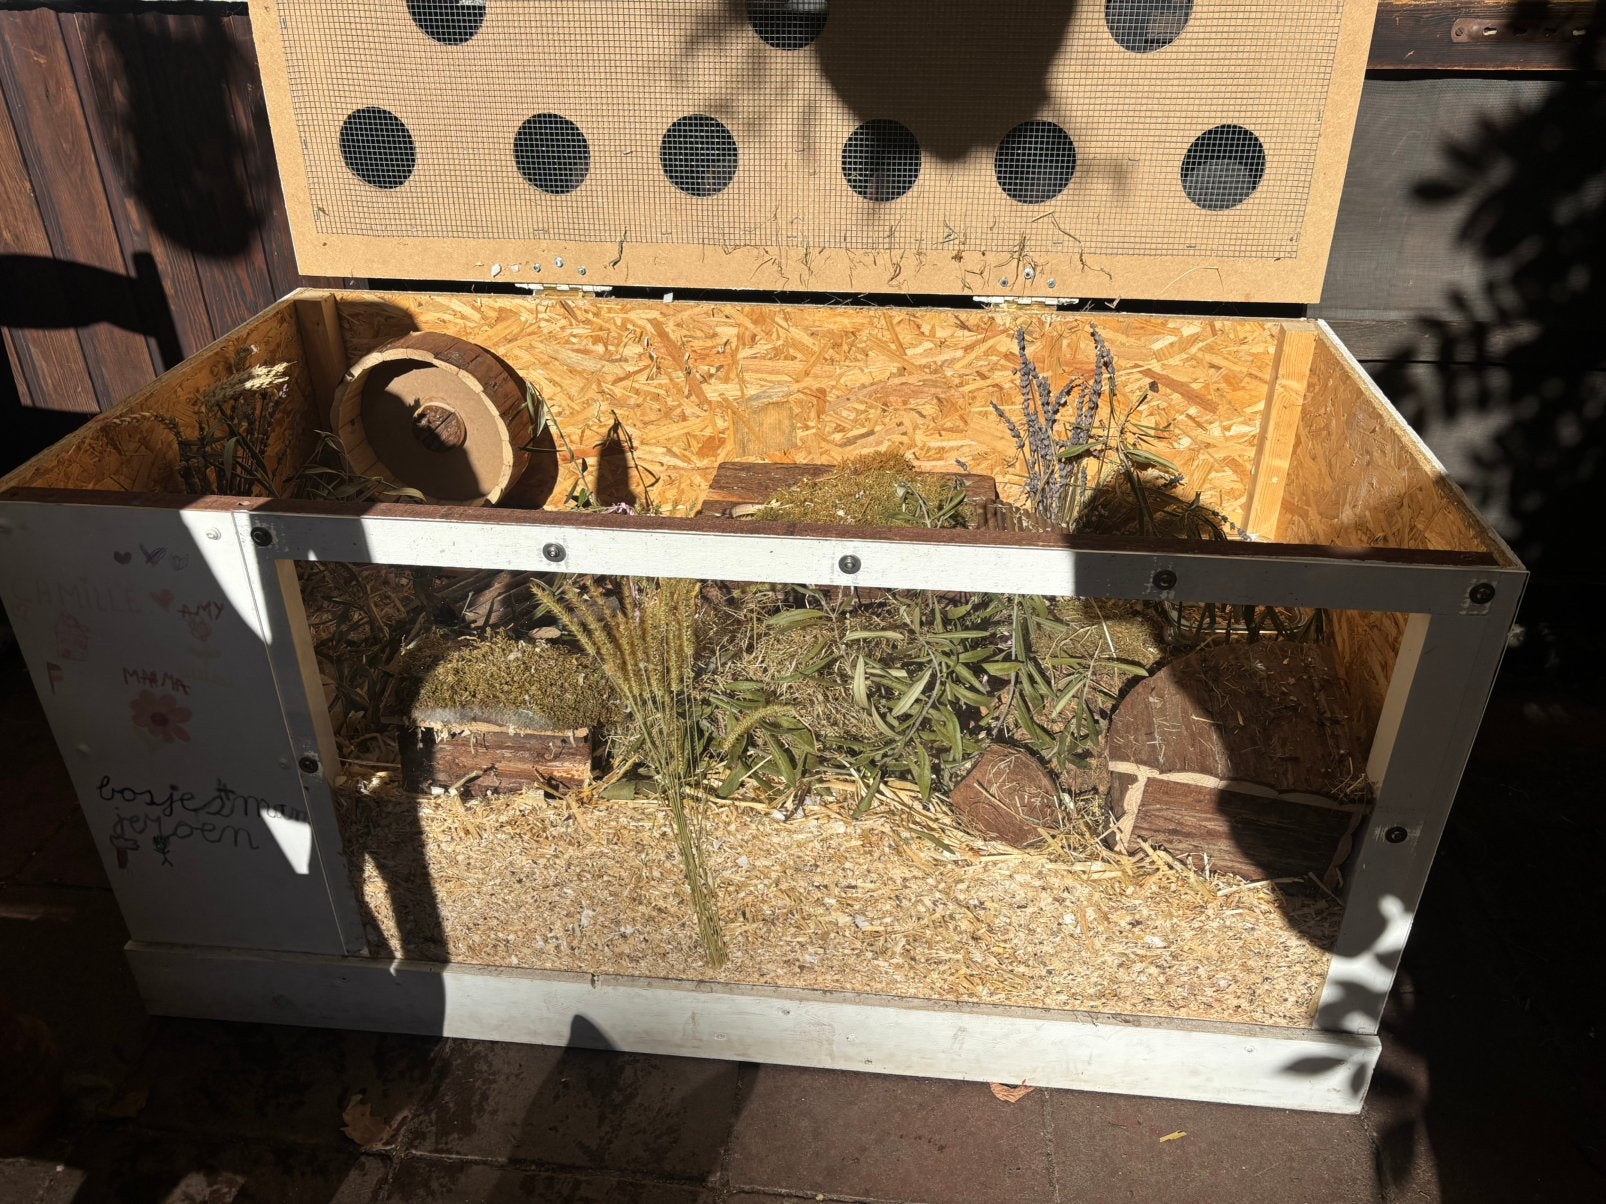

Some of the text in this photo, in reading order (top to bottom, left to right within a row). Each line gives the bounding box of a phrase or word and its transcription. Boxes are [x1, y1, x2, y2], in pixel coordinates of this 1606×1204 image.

[177, 600, 225, 621] AMY
[121, 666, 192, 695] MAMA
[112, 805, 260, 850] jeroen
